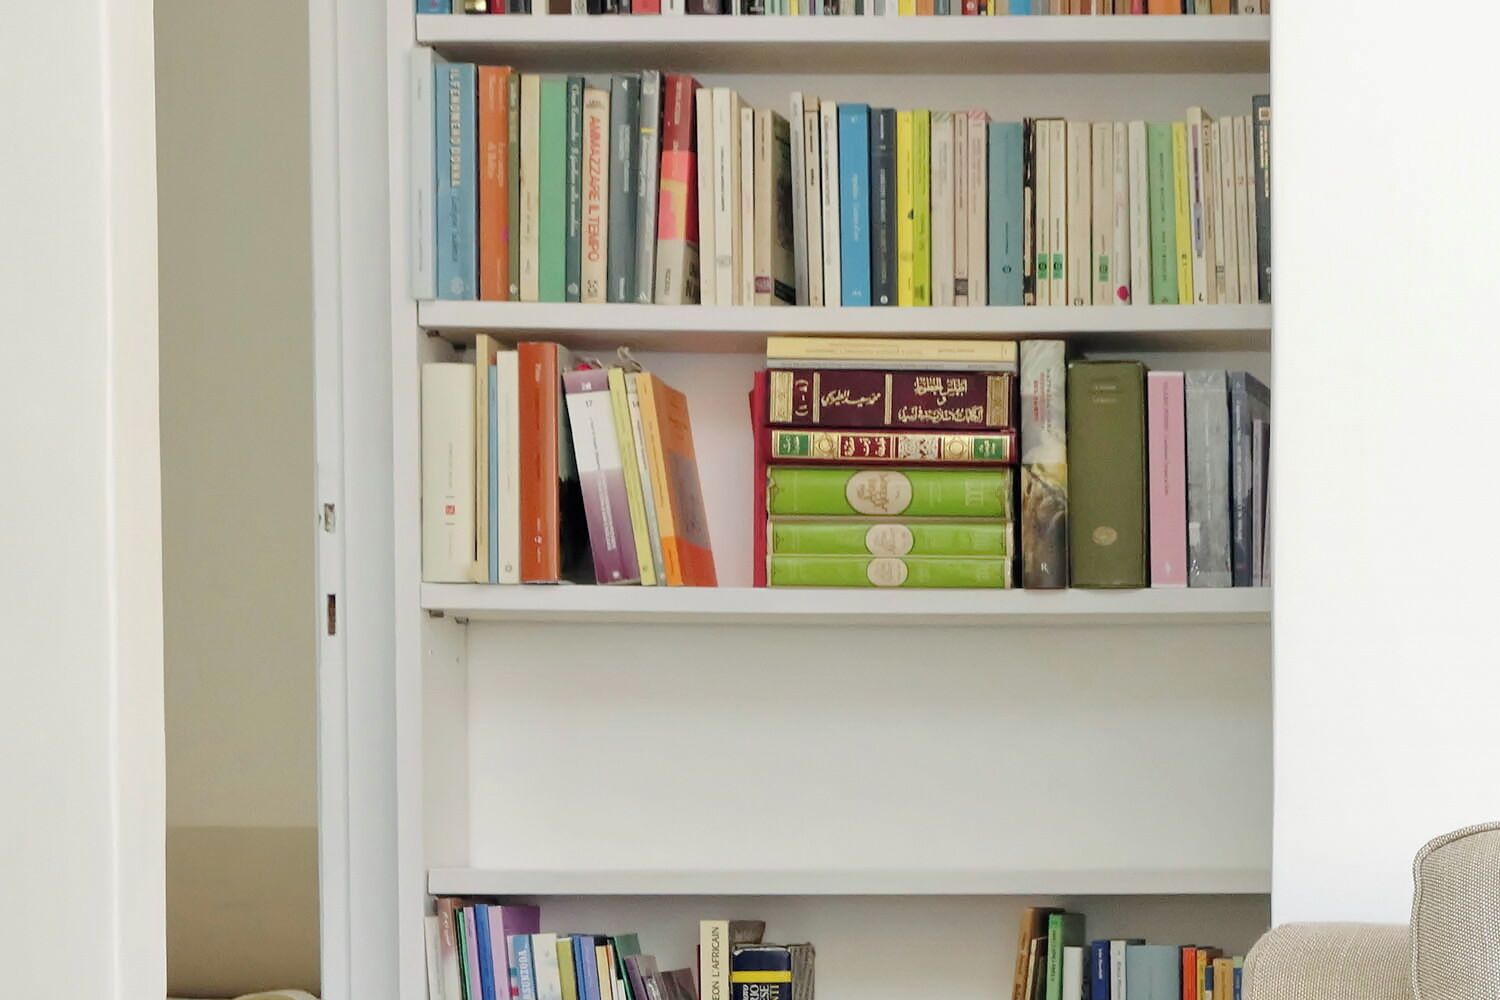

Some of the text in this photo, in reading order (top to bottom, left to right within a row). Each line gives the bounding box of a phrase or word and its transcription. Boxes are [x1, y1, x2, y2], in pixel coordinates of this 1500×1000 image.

[449, 82, 461, 145] FENOMENO
[588, 116, 601, 262] AMMAZZARE IL TEMPO
[712, 926, 720, 977] L'AFRICAIN
